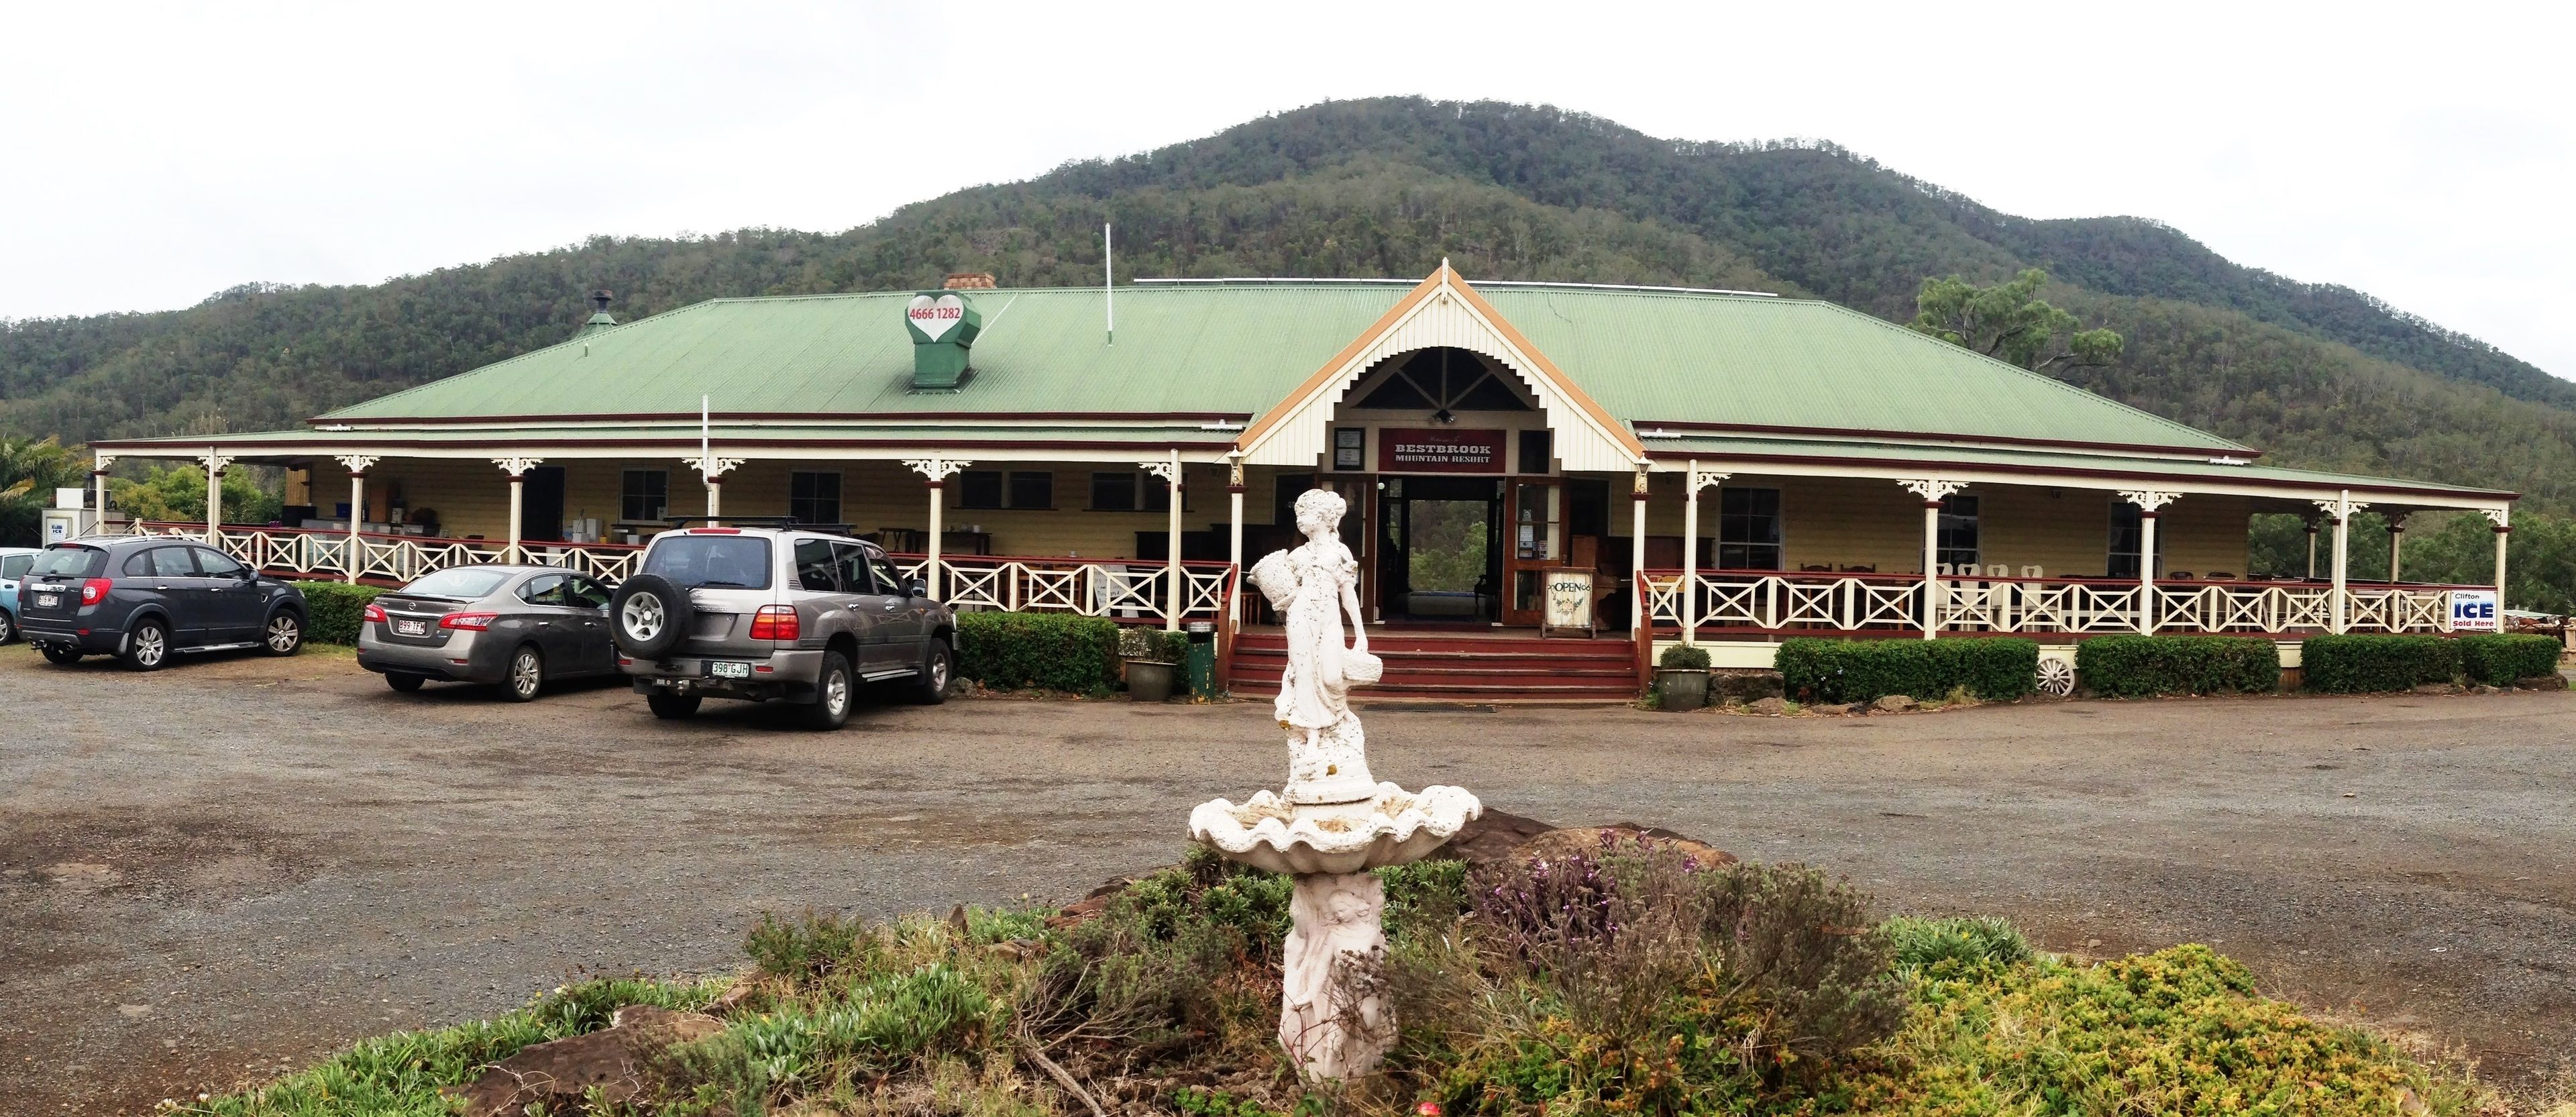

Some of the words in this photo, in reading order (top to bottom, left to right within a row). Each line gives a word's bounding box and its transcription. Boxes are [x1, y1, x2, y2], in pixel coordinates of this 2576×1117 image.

[910, 308, 934, 319] 4666
[936, 307, 960, 319] 1282
[1395, 444, 1491, 454] BESTBROOK
[1555, 582, 1582, 592] OPEN
[2454, 601, 2493, 619] ICE
[714, 663, 728, 673] 398
[731, 664, 748, 674] GJH
